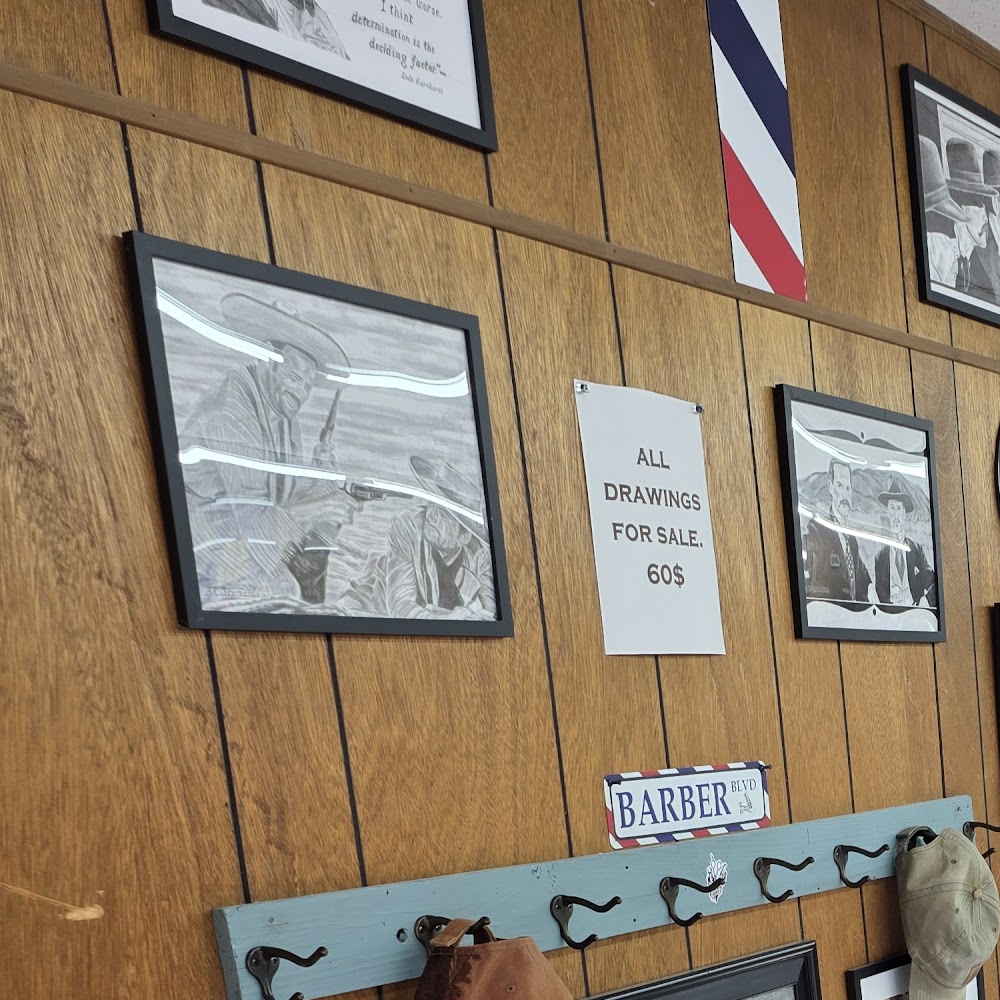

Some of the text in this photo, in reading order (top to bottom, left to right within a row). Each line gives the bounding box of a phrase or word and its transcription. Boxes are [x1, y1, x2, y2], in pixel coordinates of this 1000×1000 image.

[390, 6, 414, 25] think
[352, 11, 436, 54] determination is the
[369, 37, 408, 69] deciding
[636, 447, 671, 470] ALL
[604, 482, 701, 511] DRAWINGS
[612, 522, 704, 548] FOR SALE.
[647, 563, 685, 588] 60$
[615, 778, 757, 829] BARBER BLVD
